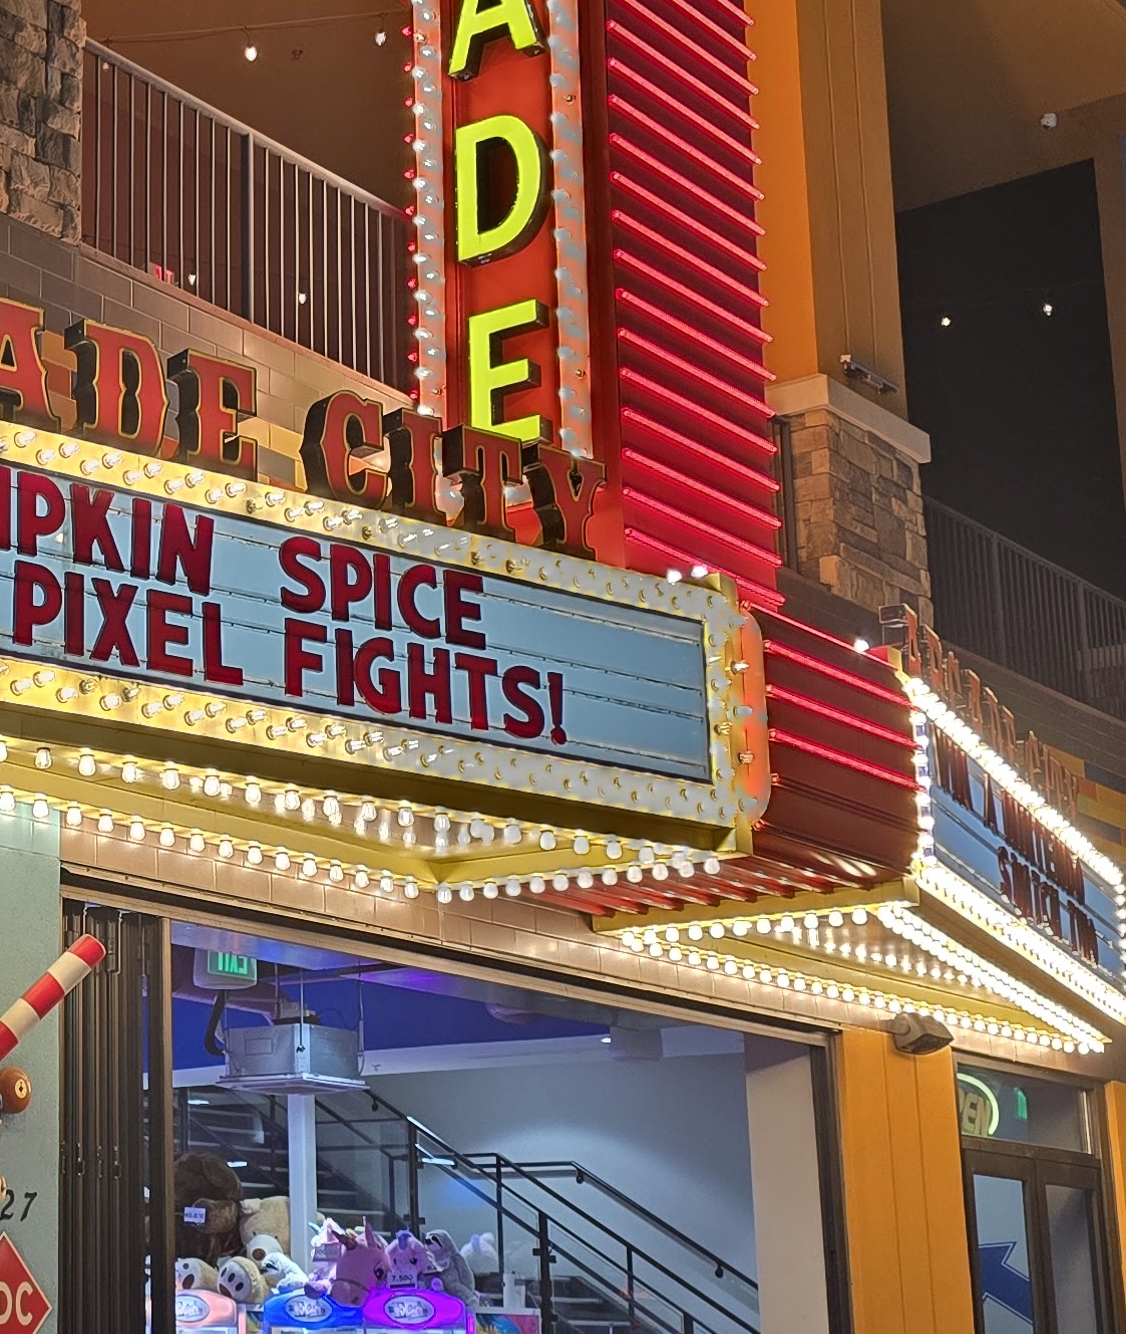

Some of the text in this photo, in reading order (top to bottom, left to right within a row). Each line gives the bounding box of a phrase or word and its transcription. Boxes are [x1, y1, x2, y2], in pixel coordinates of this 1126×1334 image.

[308, 390, 607, 561] CITY
[12, 560, 244, 687] PIXEL
[284, 617, 568, 746] FIGHTS!
[279, 536, 486, 651] SPICE
[0, 1189, 38, 1222] 27
